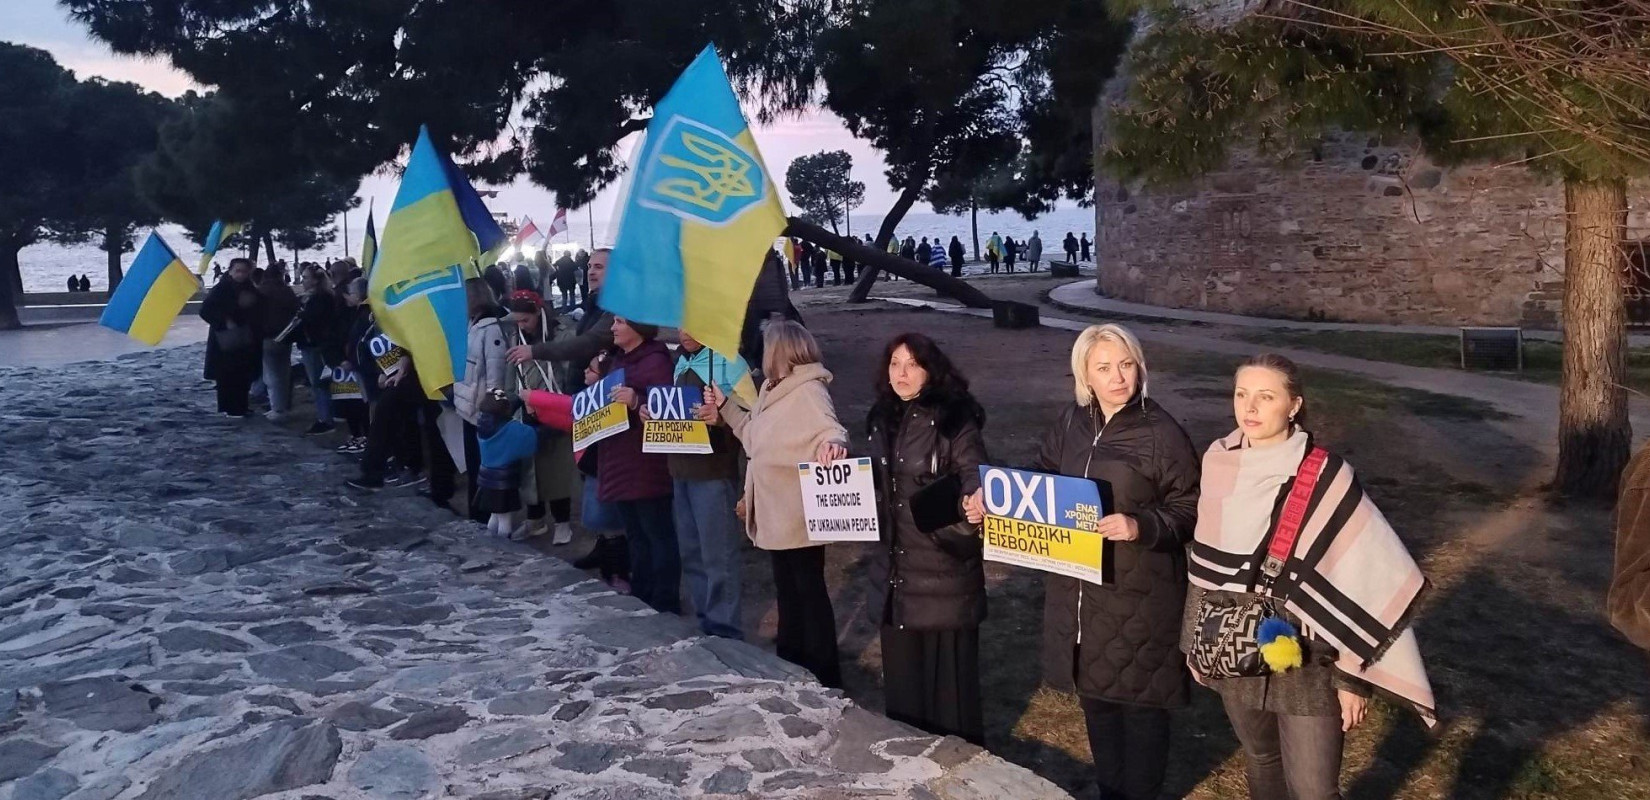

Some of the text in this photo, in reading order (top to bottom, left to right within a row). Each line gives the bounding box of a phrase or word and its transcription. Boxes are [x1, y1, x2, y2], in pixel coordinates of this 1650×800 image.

[573, 379, 605, 420] ΟΧΙ
[647, 387, 686, 420] ΟΧΙ
[646, 421, 694, 432] ΣΤΗ ΡΩΣΙΚΗ
[645, 432, 684, 443] ΕΙΣΒΟΛΗ
[815, 464, 851, 486] STOP
[816, 492, 861, 507] THE GENOCIDE
[984, 468, 1057, 526] ΟΧΙ
[1075, 502, 1099, 513] ΕΝΑΣ
[1064, 509, 1099, 522] ΧΡΟΝΟΣ
[808, 518, 877, 532] OF UKRAINIAN PEOPLE
[987, 516, 1071, 545] ΣΤΗ ΡΩΣΙΚΗ
[1075, 520, 1099, 532] ΜΕΤΑ
[987, 532, 1050, 556] ΕΙΣΒΟΛΗ
